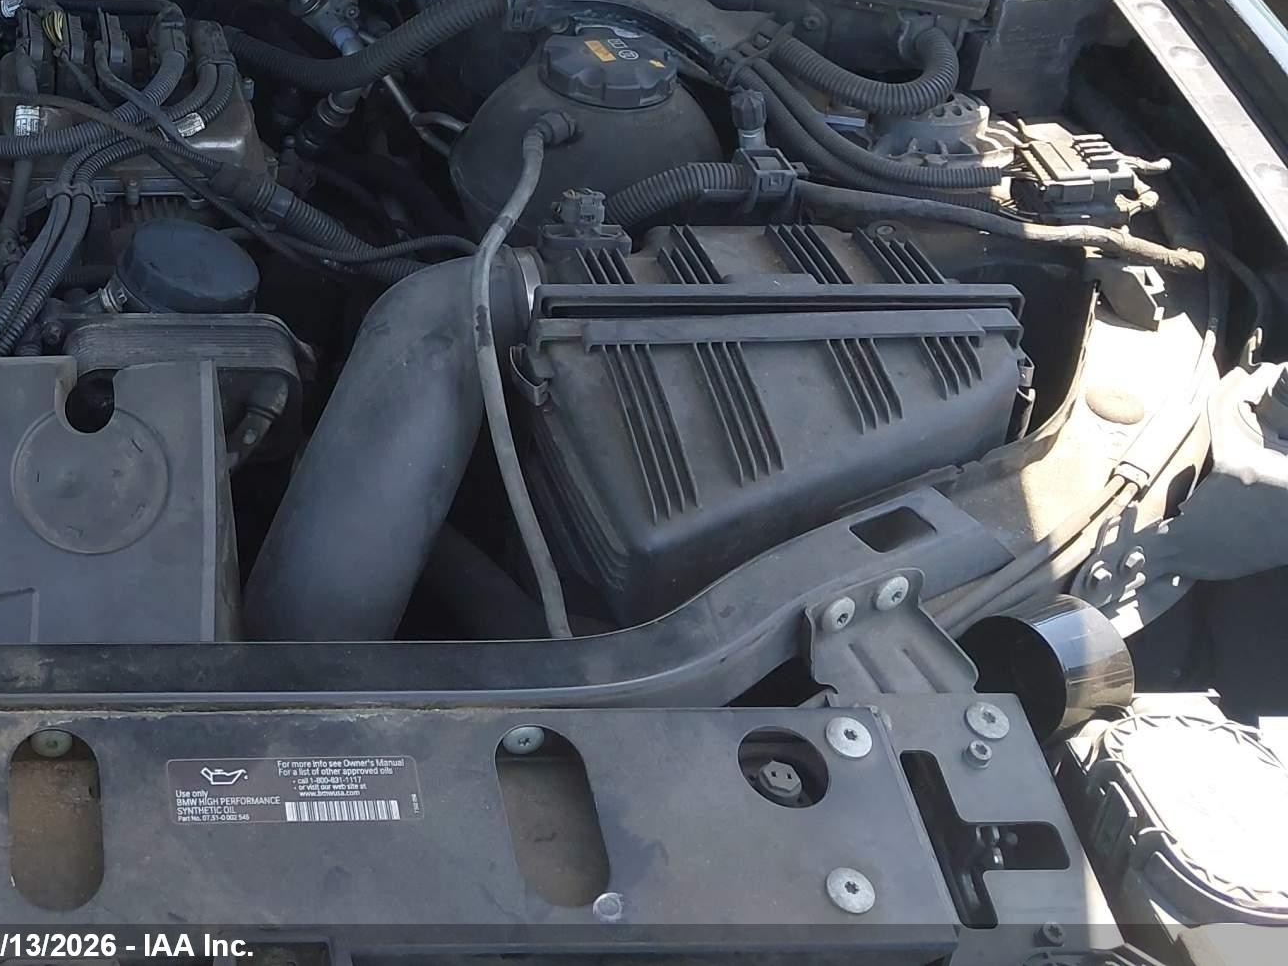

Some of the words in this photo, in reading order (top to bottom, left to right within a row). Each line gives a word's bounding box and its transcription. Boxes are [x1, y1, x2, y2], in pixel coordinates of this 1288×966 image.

[277, 760, 290, 768] For
[292, 760, 311, 768] more
[343, 759, 374, 767] Owner's
[376, 759, 405, 767] Manual
[342, 768, 378, 776] approved
[310, 776, 362, 784] 1-800-831-1117
[175, 790, 191, 798] Use
[192, 790, 209, 799] only
[176, 798, 197, 806] BMW
[199, 797, 219, 806] HIGH
[220, 796, 281, 805] PERFORMANCE
[176, 806, 222, 815] SYNTHETIC
[223, 806, 236, 814] OIL
